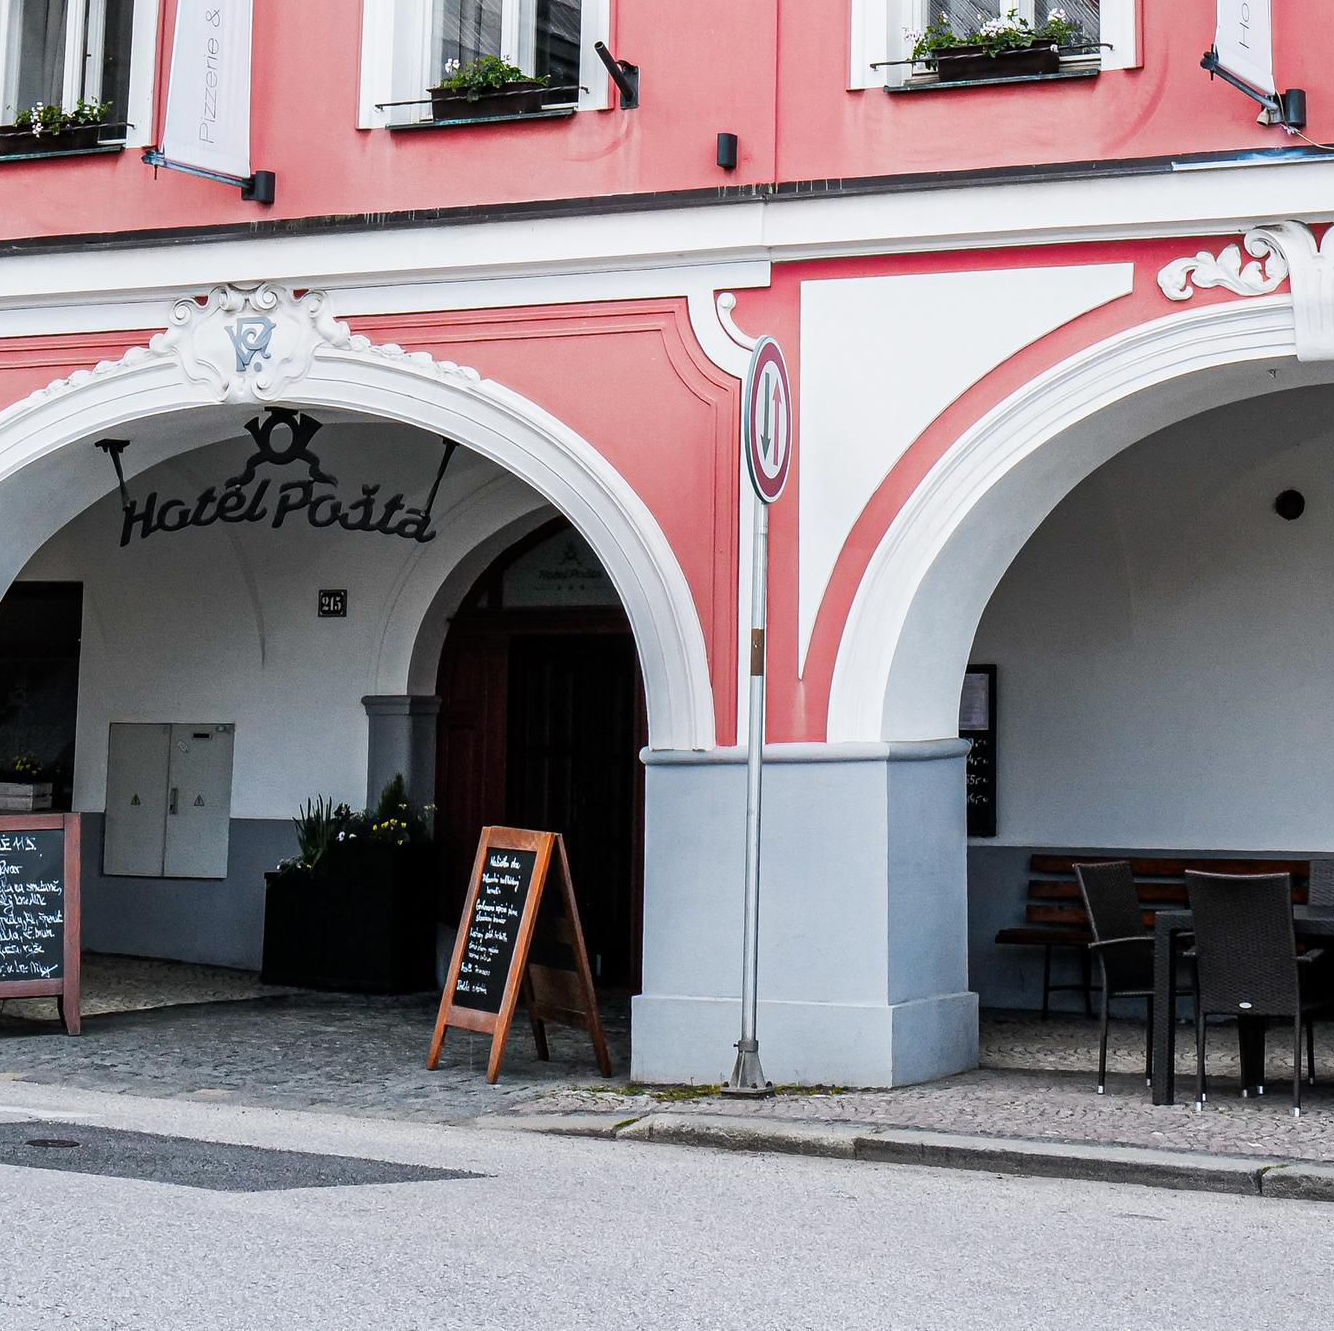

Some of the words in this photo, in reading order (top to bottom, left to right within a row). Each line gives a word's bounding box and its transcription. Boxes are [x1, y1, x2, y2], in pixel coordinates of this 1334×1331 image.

[205, 9, 220, 28] &
[198, 37, 219, 144] Pizzerie
[271, 479, 437, 543] Pošta
[322, 596, 342, 611] 215
